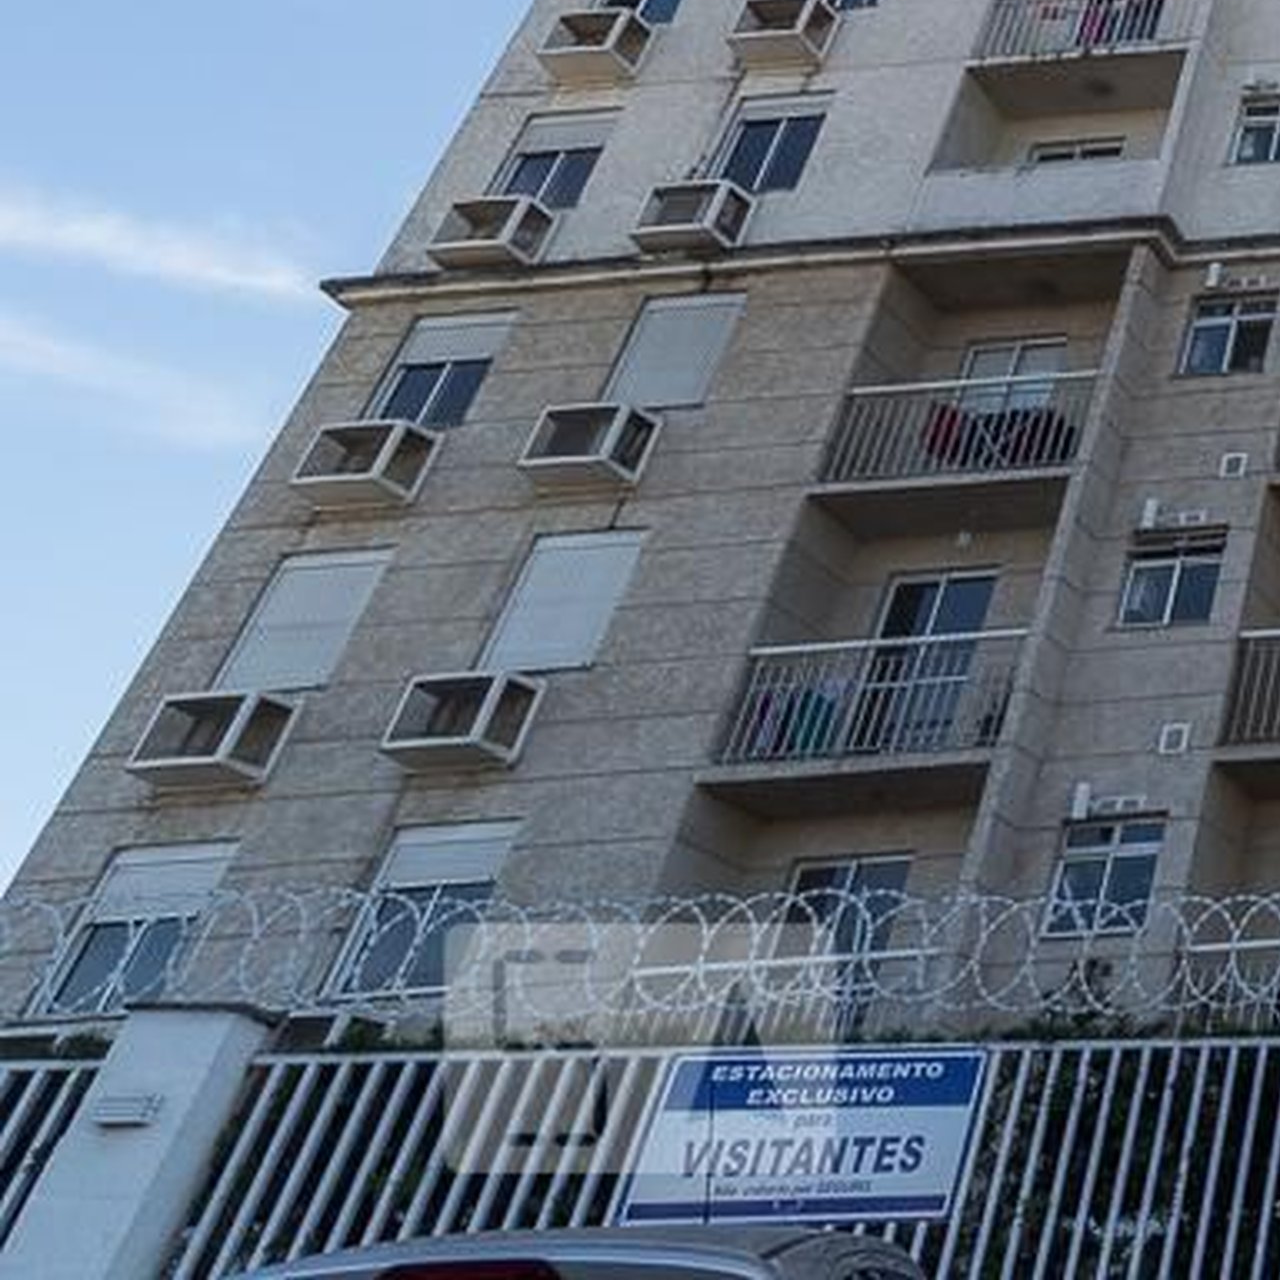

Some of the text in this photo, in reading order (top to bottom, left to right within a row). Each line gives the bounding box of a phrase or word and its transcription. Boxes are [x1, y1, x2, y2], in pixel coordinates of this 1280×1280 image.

[712, 1061, 945, 1081] ESTACIONAMENTO
[746, 1085, 895, 1105] EXCLUSIVO
[682, 1135, 925, 1177] VISITANTES
